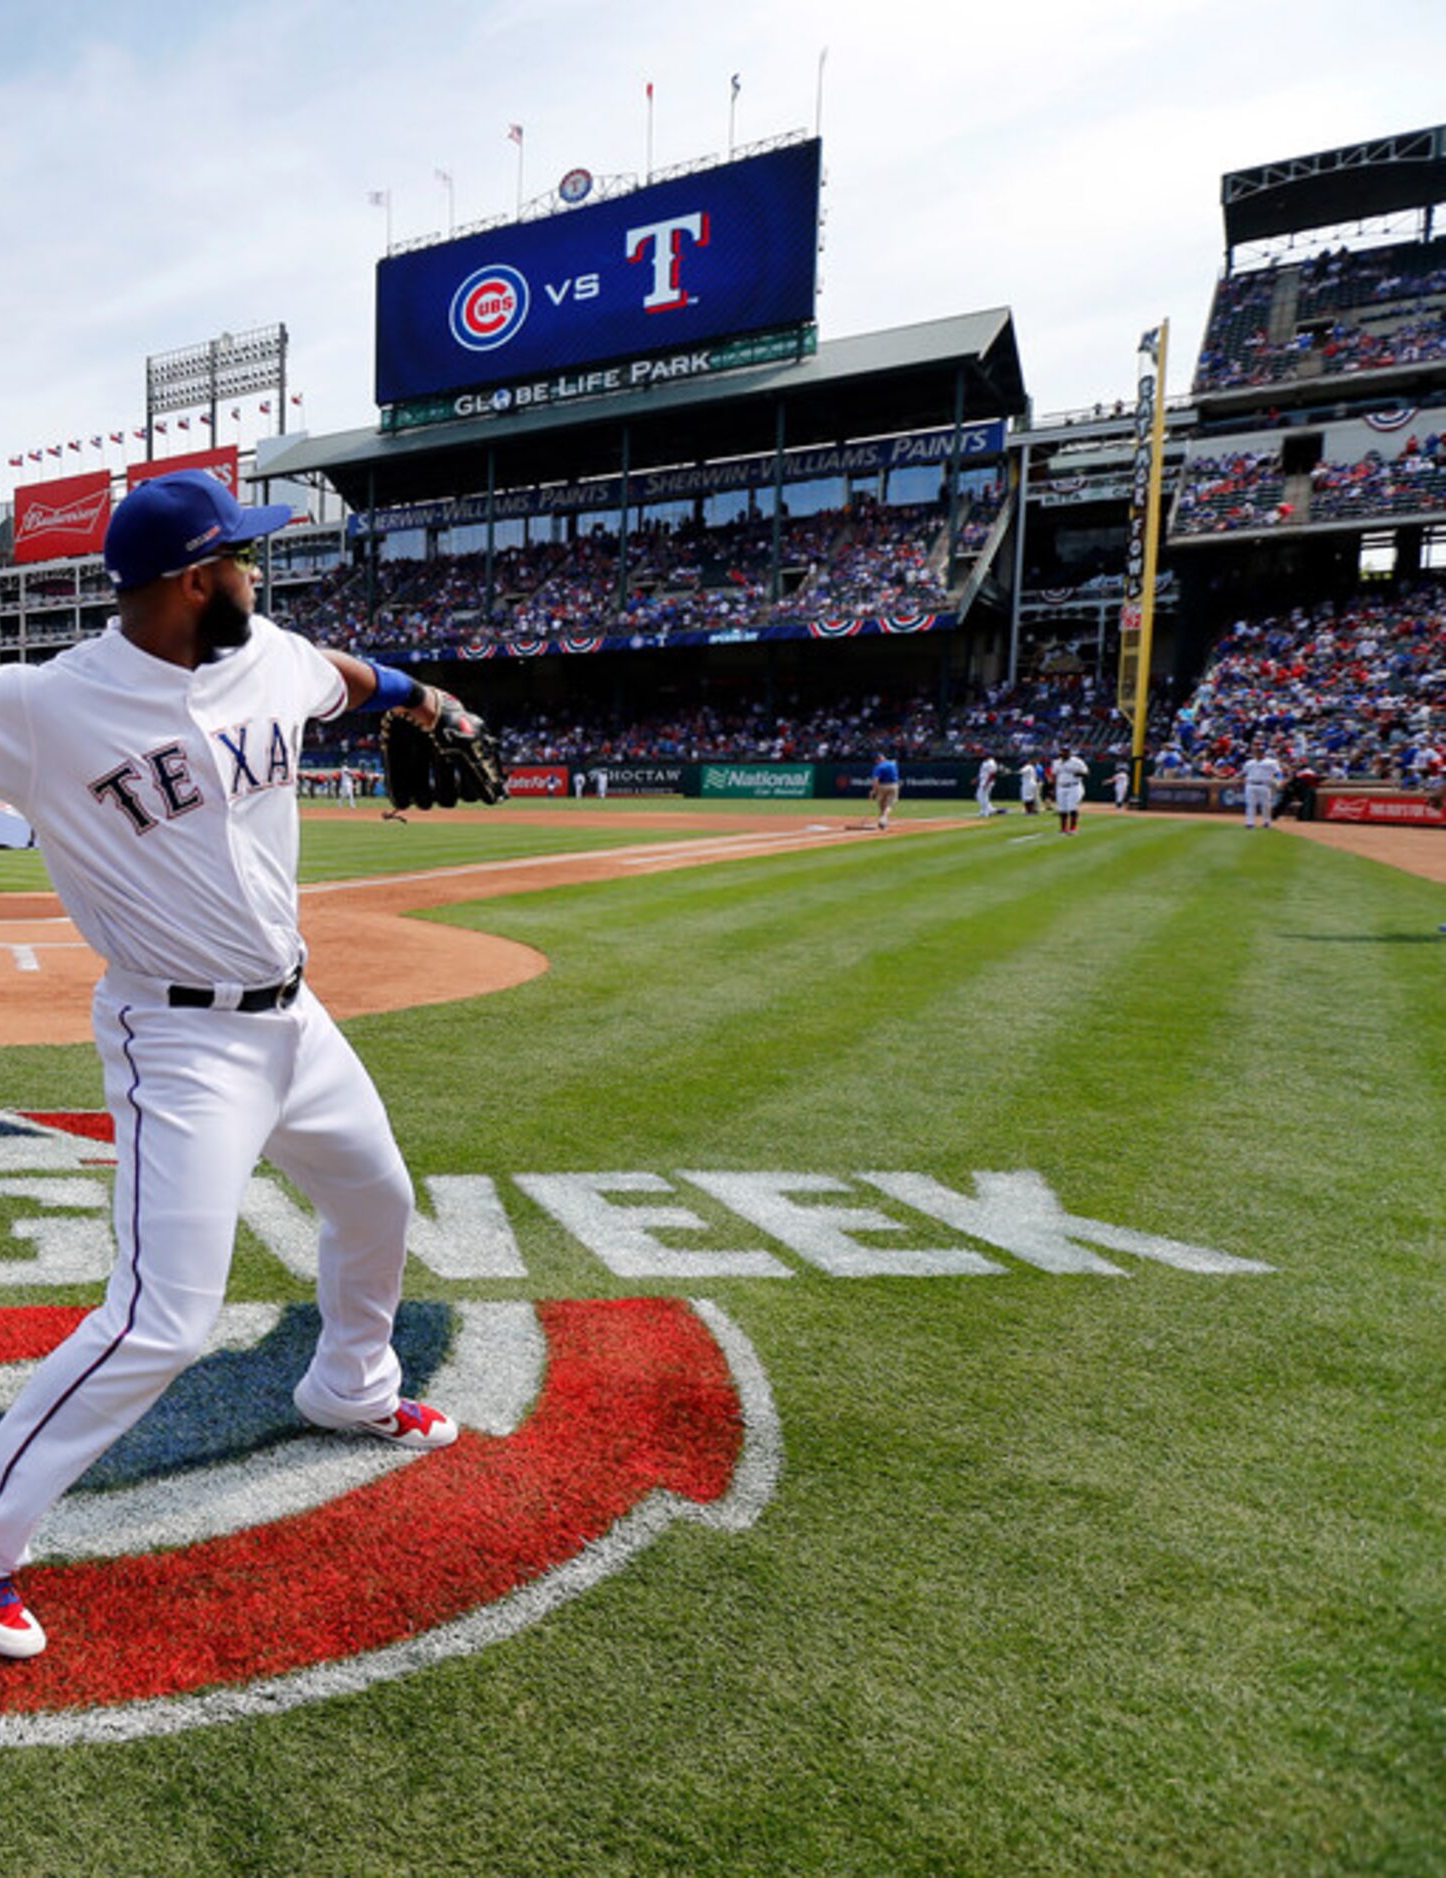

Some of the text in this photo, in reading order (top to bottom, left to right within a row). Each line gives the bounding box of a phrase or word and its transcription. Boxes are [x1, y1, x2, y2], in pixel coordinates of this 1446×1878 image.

[545, 273, 600, 305] VS
[626, 211, 711, 315] T
[558, 367, 621, 398] LIFE
[631, 351, 711, 383] PARK
[889, 428, 988, 462] PAINTS
[538, 484, 609, 510] PAINTS
[21, 503, 101, 532] Budweiser
[1128, 516, 1145, 598] FOWL
[87, 717, 299, 837] TEXA
[607, 769, 682, 782] HOCTAW
[727, 770, 811, 787] National
[236, 1174, 1280, 1280] WEEK
